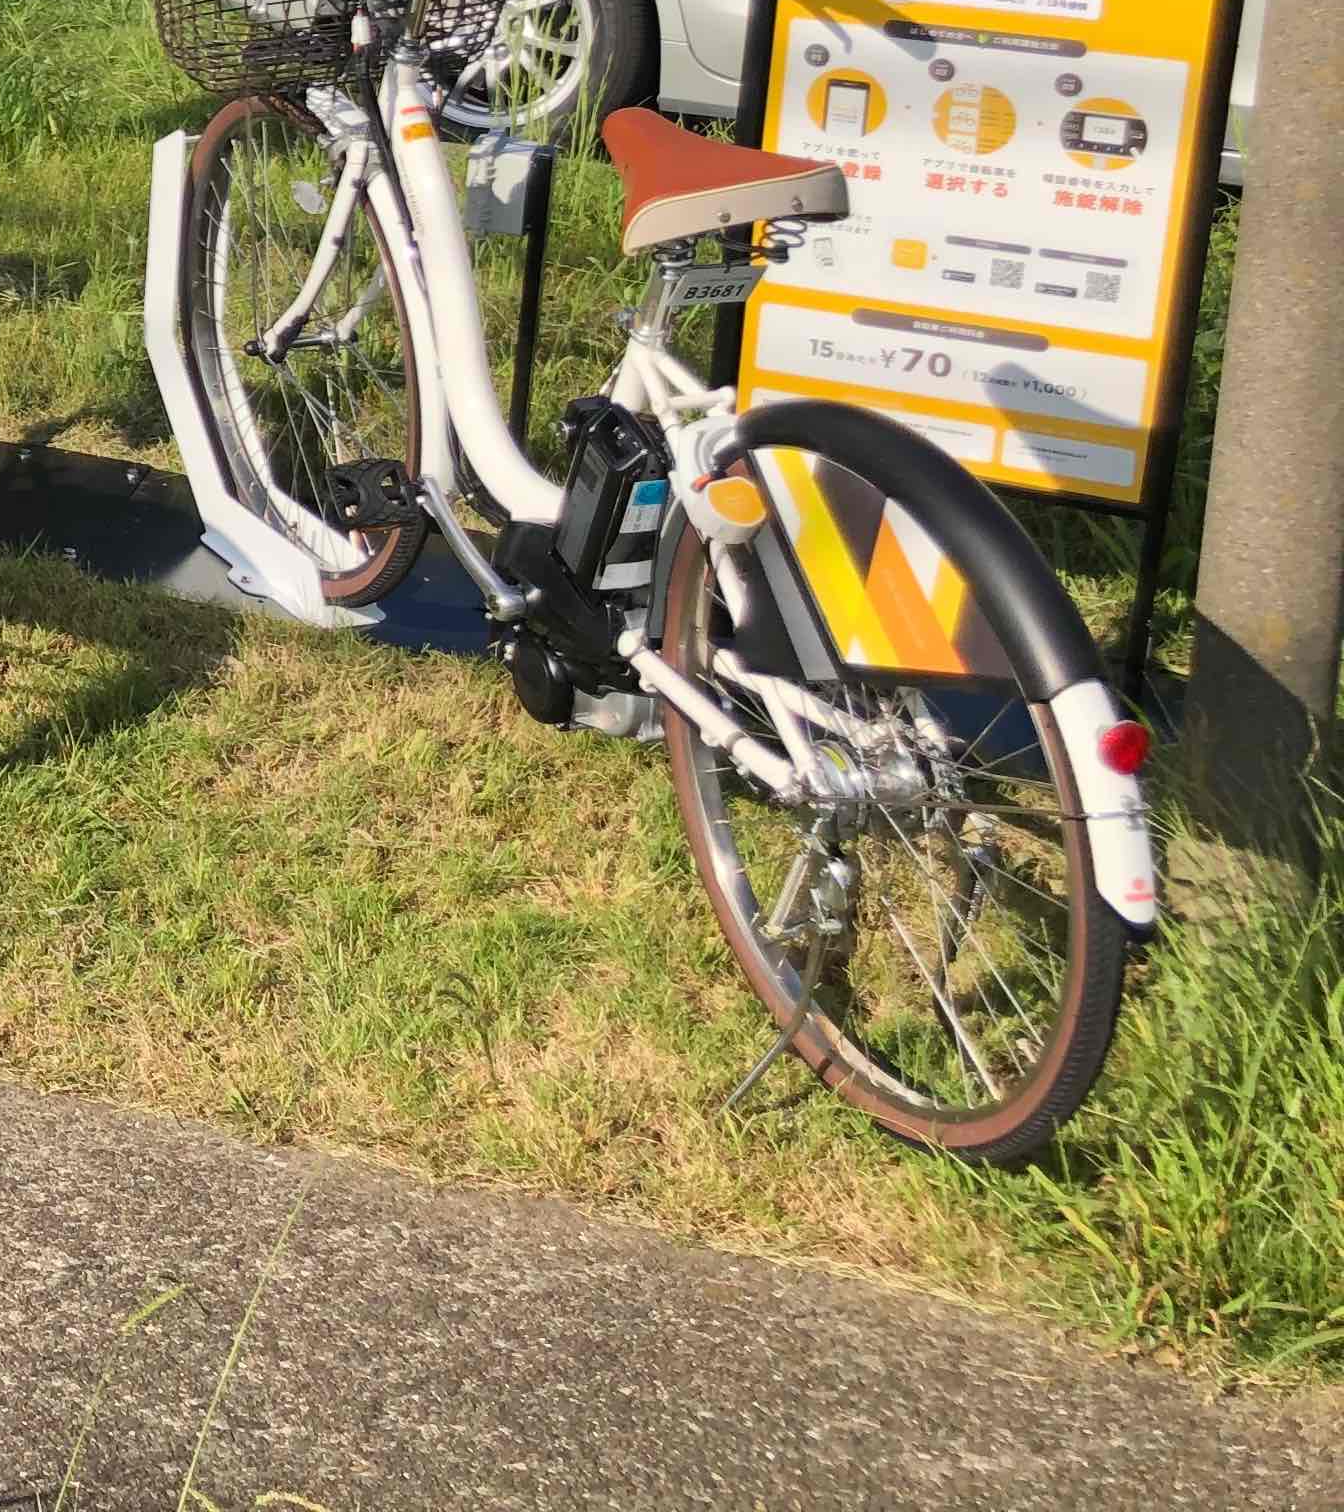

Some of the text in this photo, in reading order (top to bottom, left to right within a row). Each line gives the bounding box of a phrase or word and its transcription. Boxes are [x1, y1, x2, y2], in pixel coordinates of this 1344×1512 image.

[925, 173, 1009, 198] 選択する
[683, 284, 745, 299] B3681
